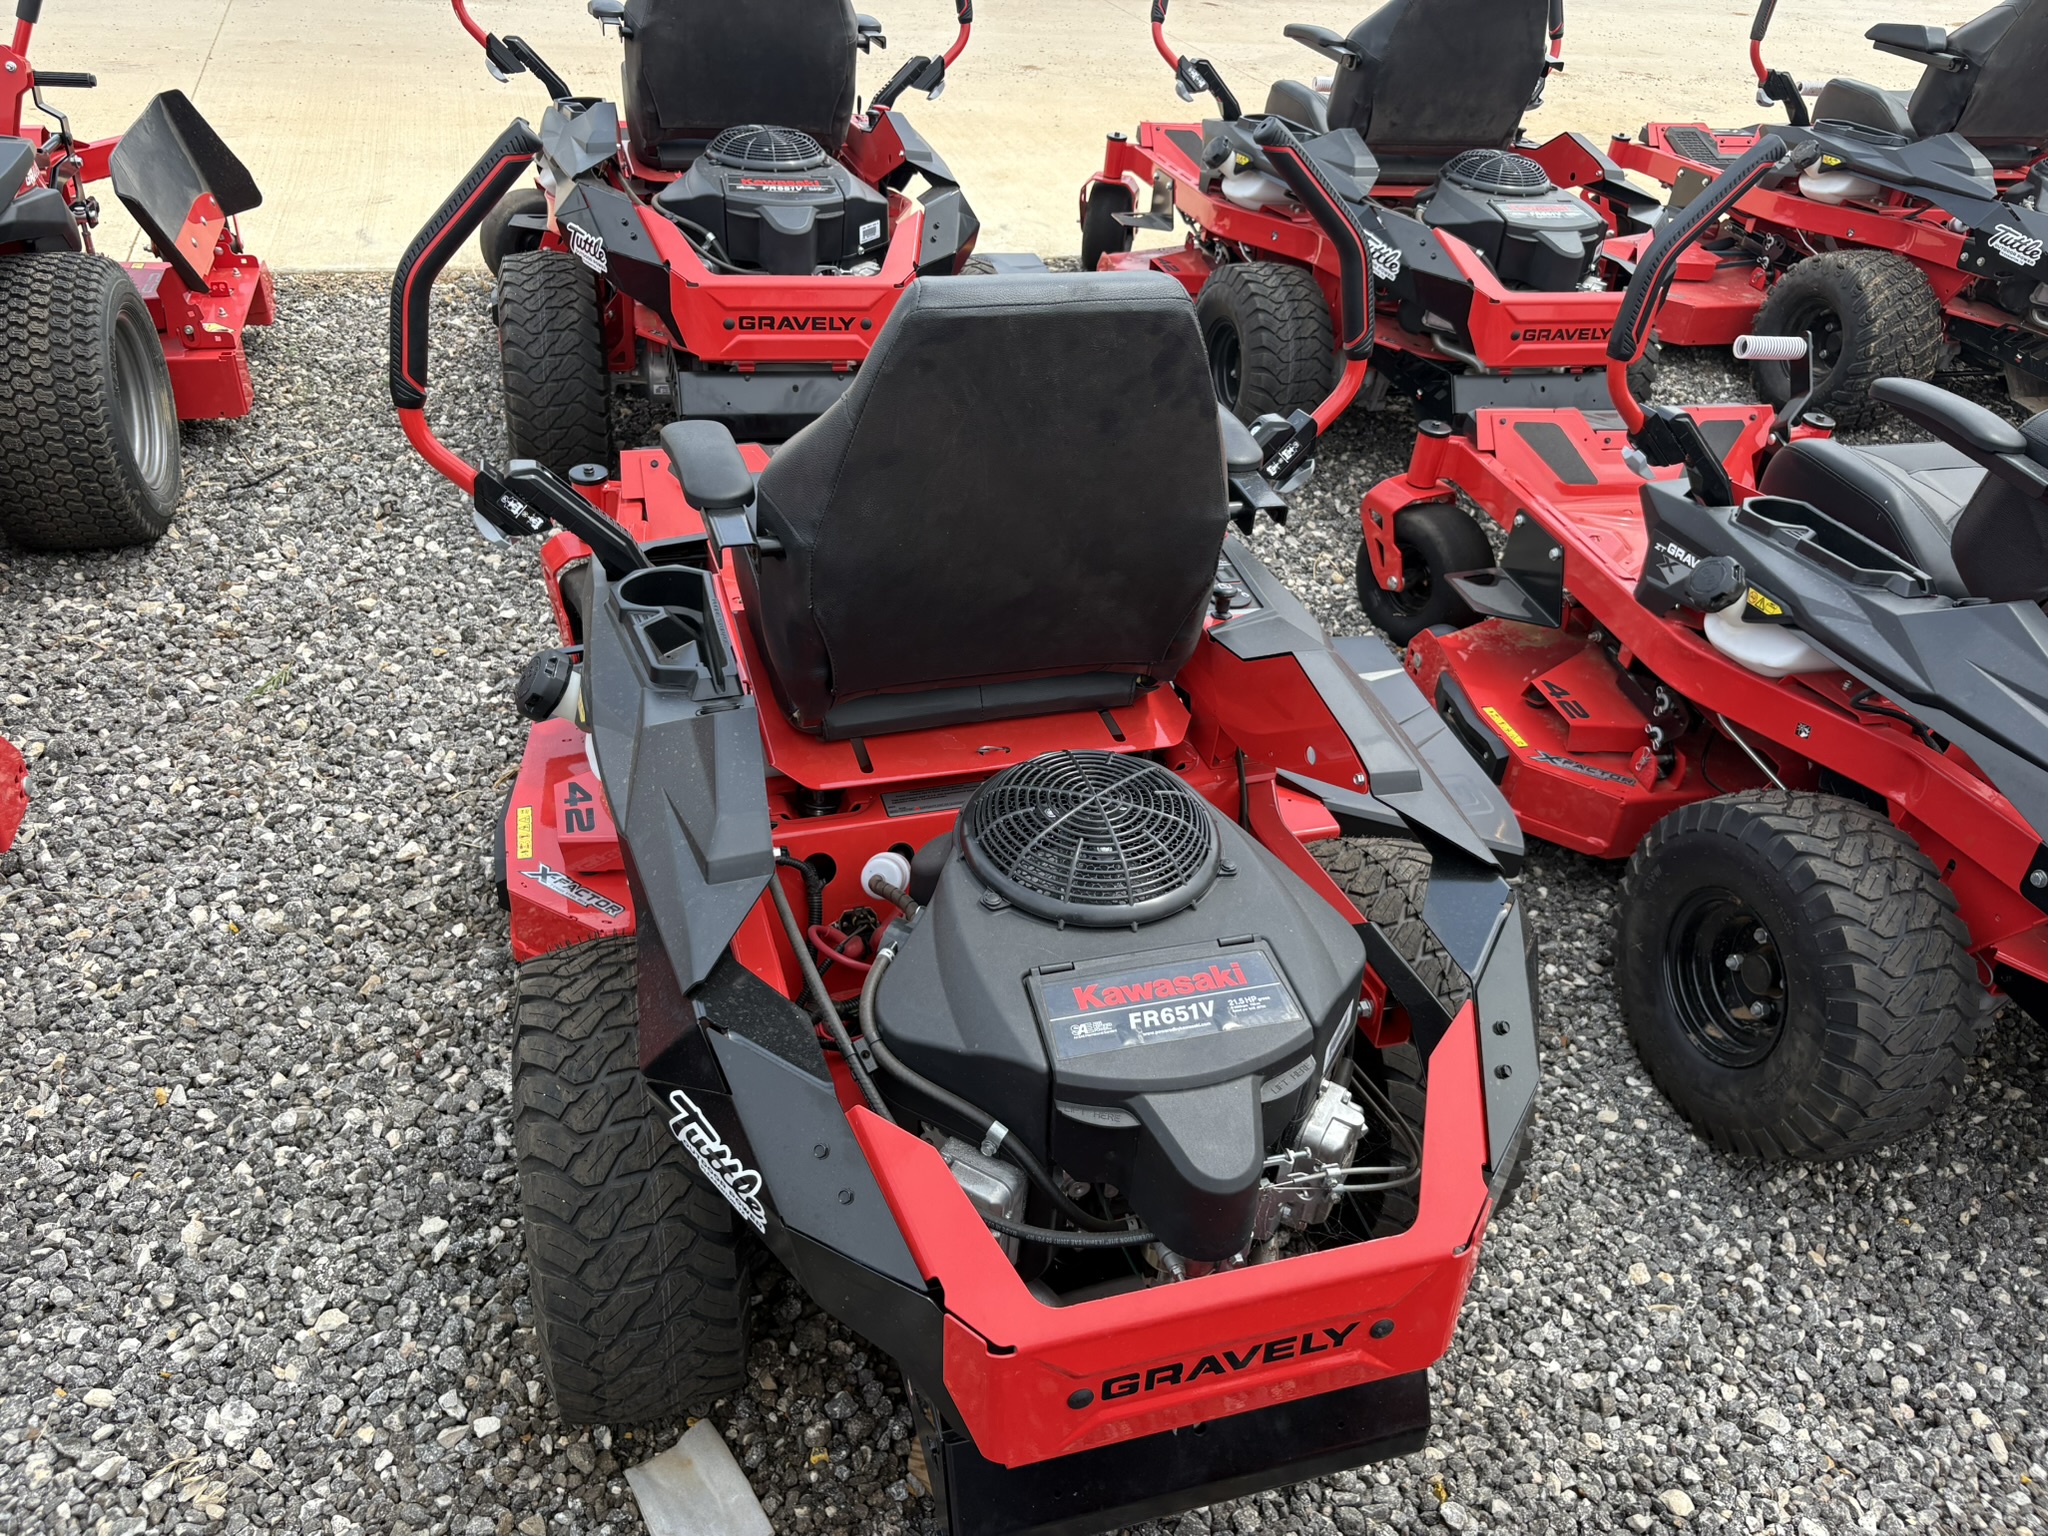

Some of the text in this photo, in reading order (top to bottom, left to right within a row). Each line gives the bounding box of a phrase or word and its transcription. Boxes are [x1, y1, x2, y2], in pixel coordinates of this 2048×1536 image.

[567, 222, 607, 265] Tuttle
[1988, 224, 2043, 260] Tuttle
[738, 315, 857, 331] GRAVELY
[1522, 327, 1613, 341] GRAVELY
[1654, 542, 1701, 569] ZT GRAV
[1540, 679, 1591, 719] 42
[564, 781, 596, 834] 42
[521, 863, 625, 917] X-FACTOR
[1072, 962, 1248, 1012] Kawasaki
[1128, 1000, 1215, 1030] FR651V
[1271, 1062, 1312, 1095] LIFT HERE
[1093, 1111, 1121, 1123] HERE
[670, 1091, 767, 1221] Tuttle
[682, 1138, 764, 1229] OUTDOOR POWER
[1101, 1321, 1361, 1401] GRAVELY
